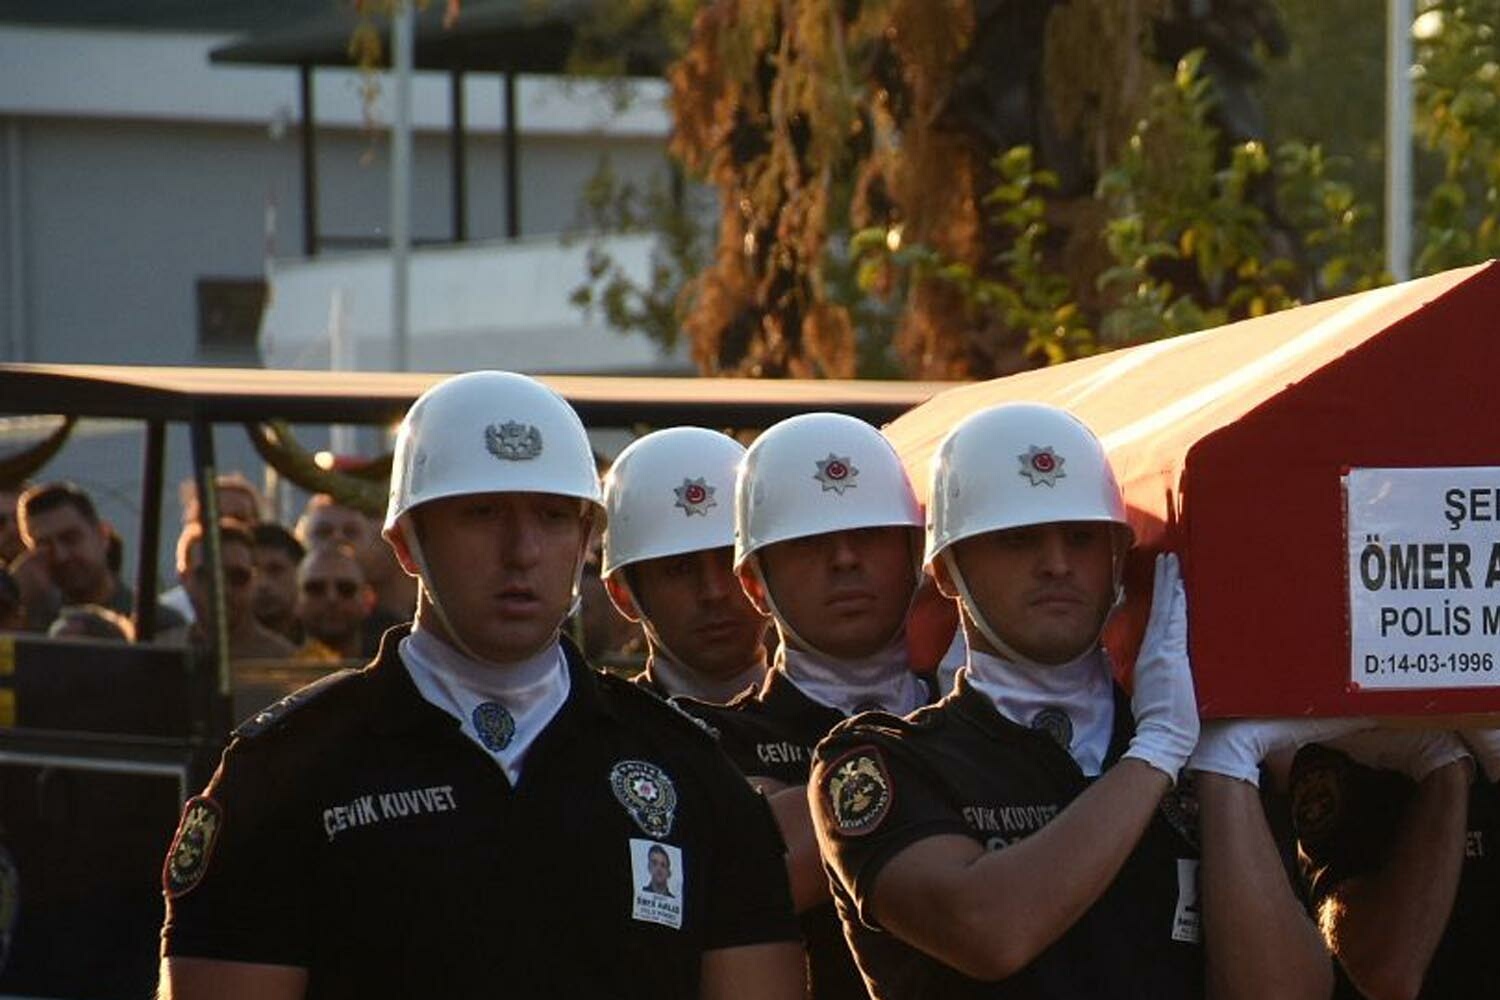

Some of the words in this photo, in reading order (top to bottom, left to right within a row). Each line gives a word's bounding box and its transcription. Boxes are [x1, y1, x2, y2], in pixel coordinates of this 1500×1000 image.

[1360, 534, 1473, 591] ÖMER
[1381, 599, 1472, 637] POLİS
[1365, 653, 1494, 674] D:14-03-1996
[323, 794, 380, 842] ÇEVİK
[378, 785, 457, 819] KUVVET
